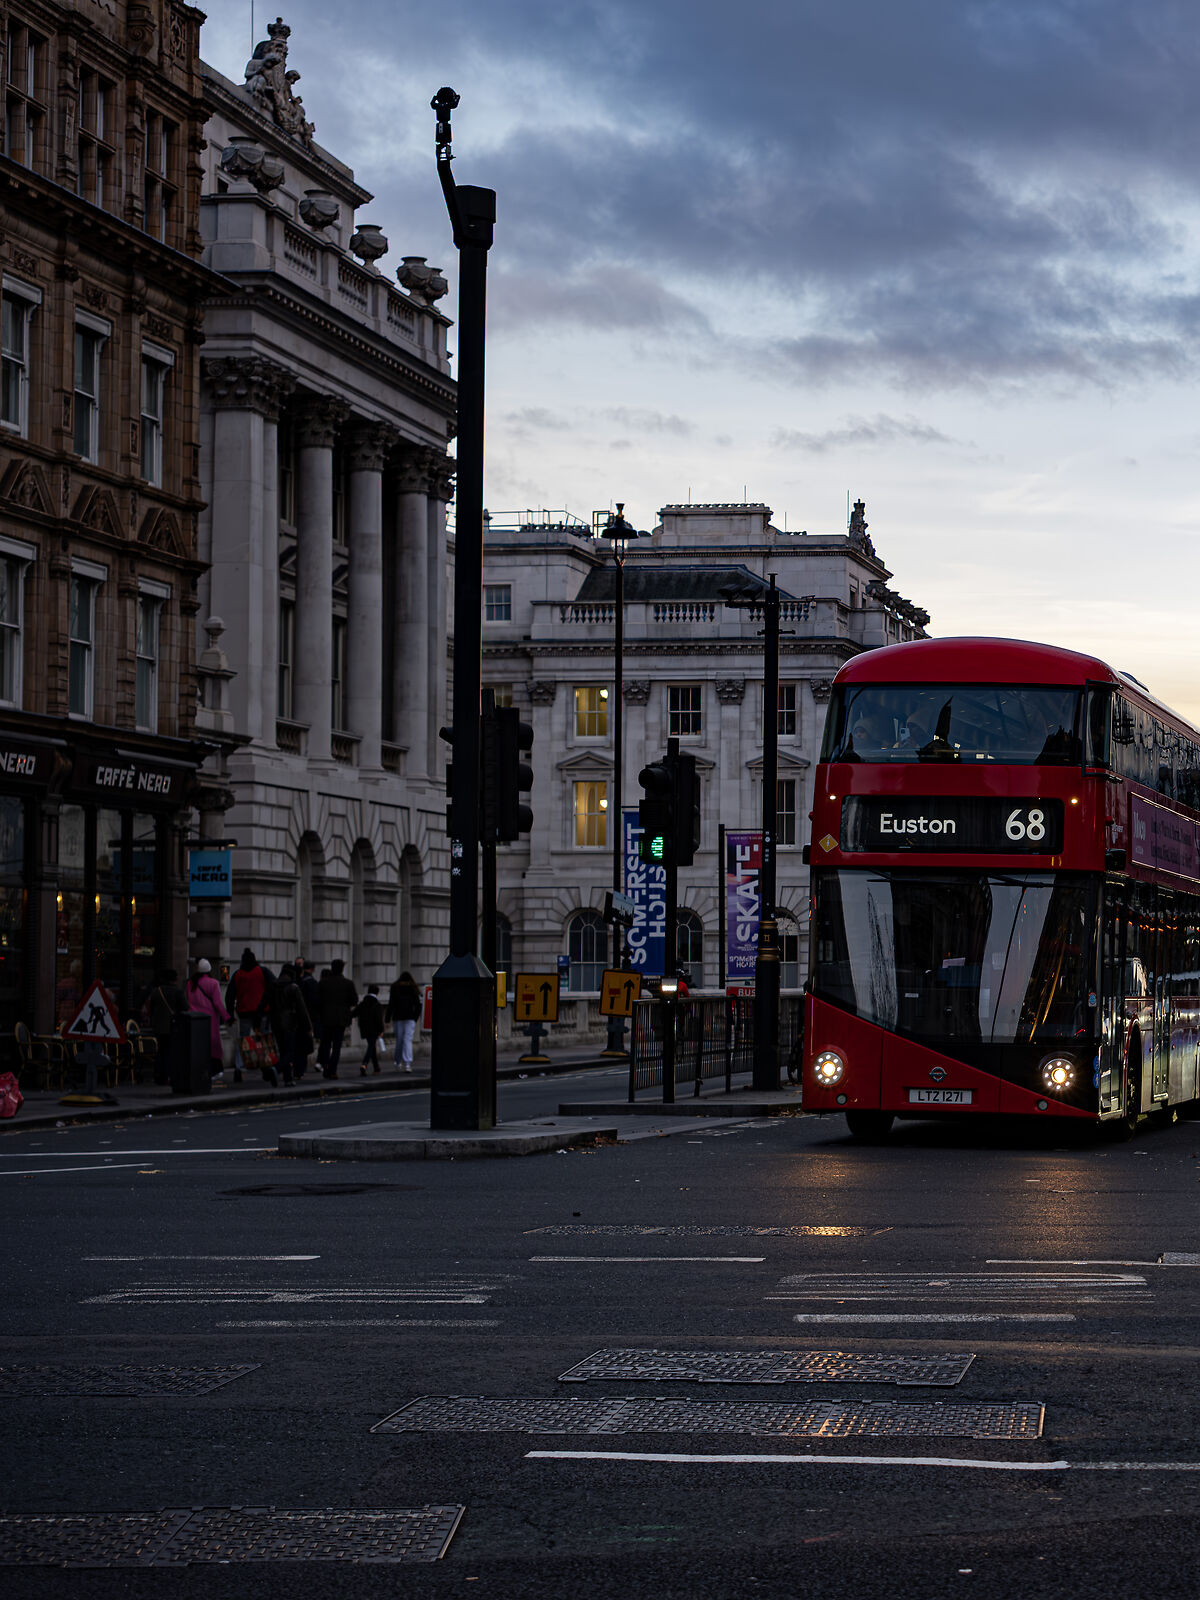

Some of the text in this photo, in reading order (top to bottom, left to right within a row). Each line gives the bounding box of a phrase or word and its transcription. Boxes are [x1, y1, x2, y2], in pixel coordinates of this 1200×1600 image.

[0, 752, 37, 775] NERO
[138, 772, 172, 794] NERO
[879, 808, 1046, 841] Euston 68
[191, 873, 228, 882] NERO
[648, 864, 667, 938] HOUS
[918, 1090, 963, 1102] LTZ 1271
